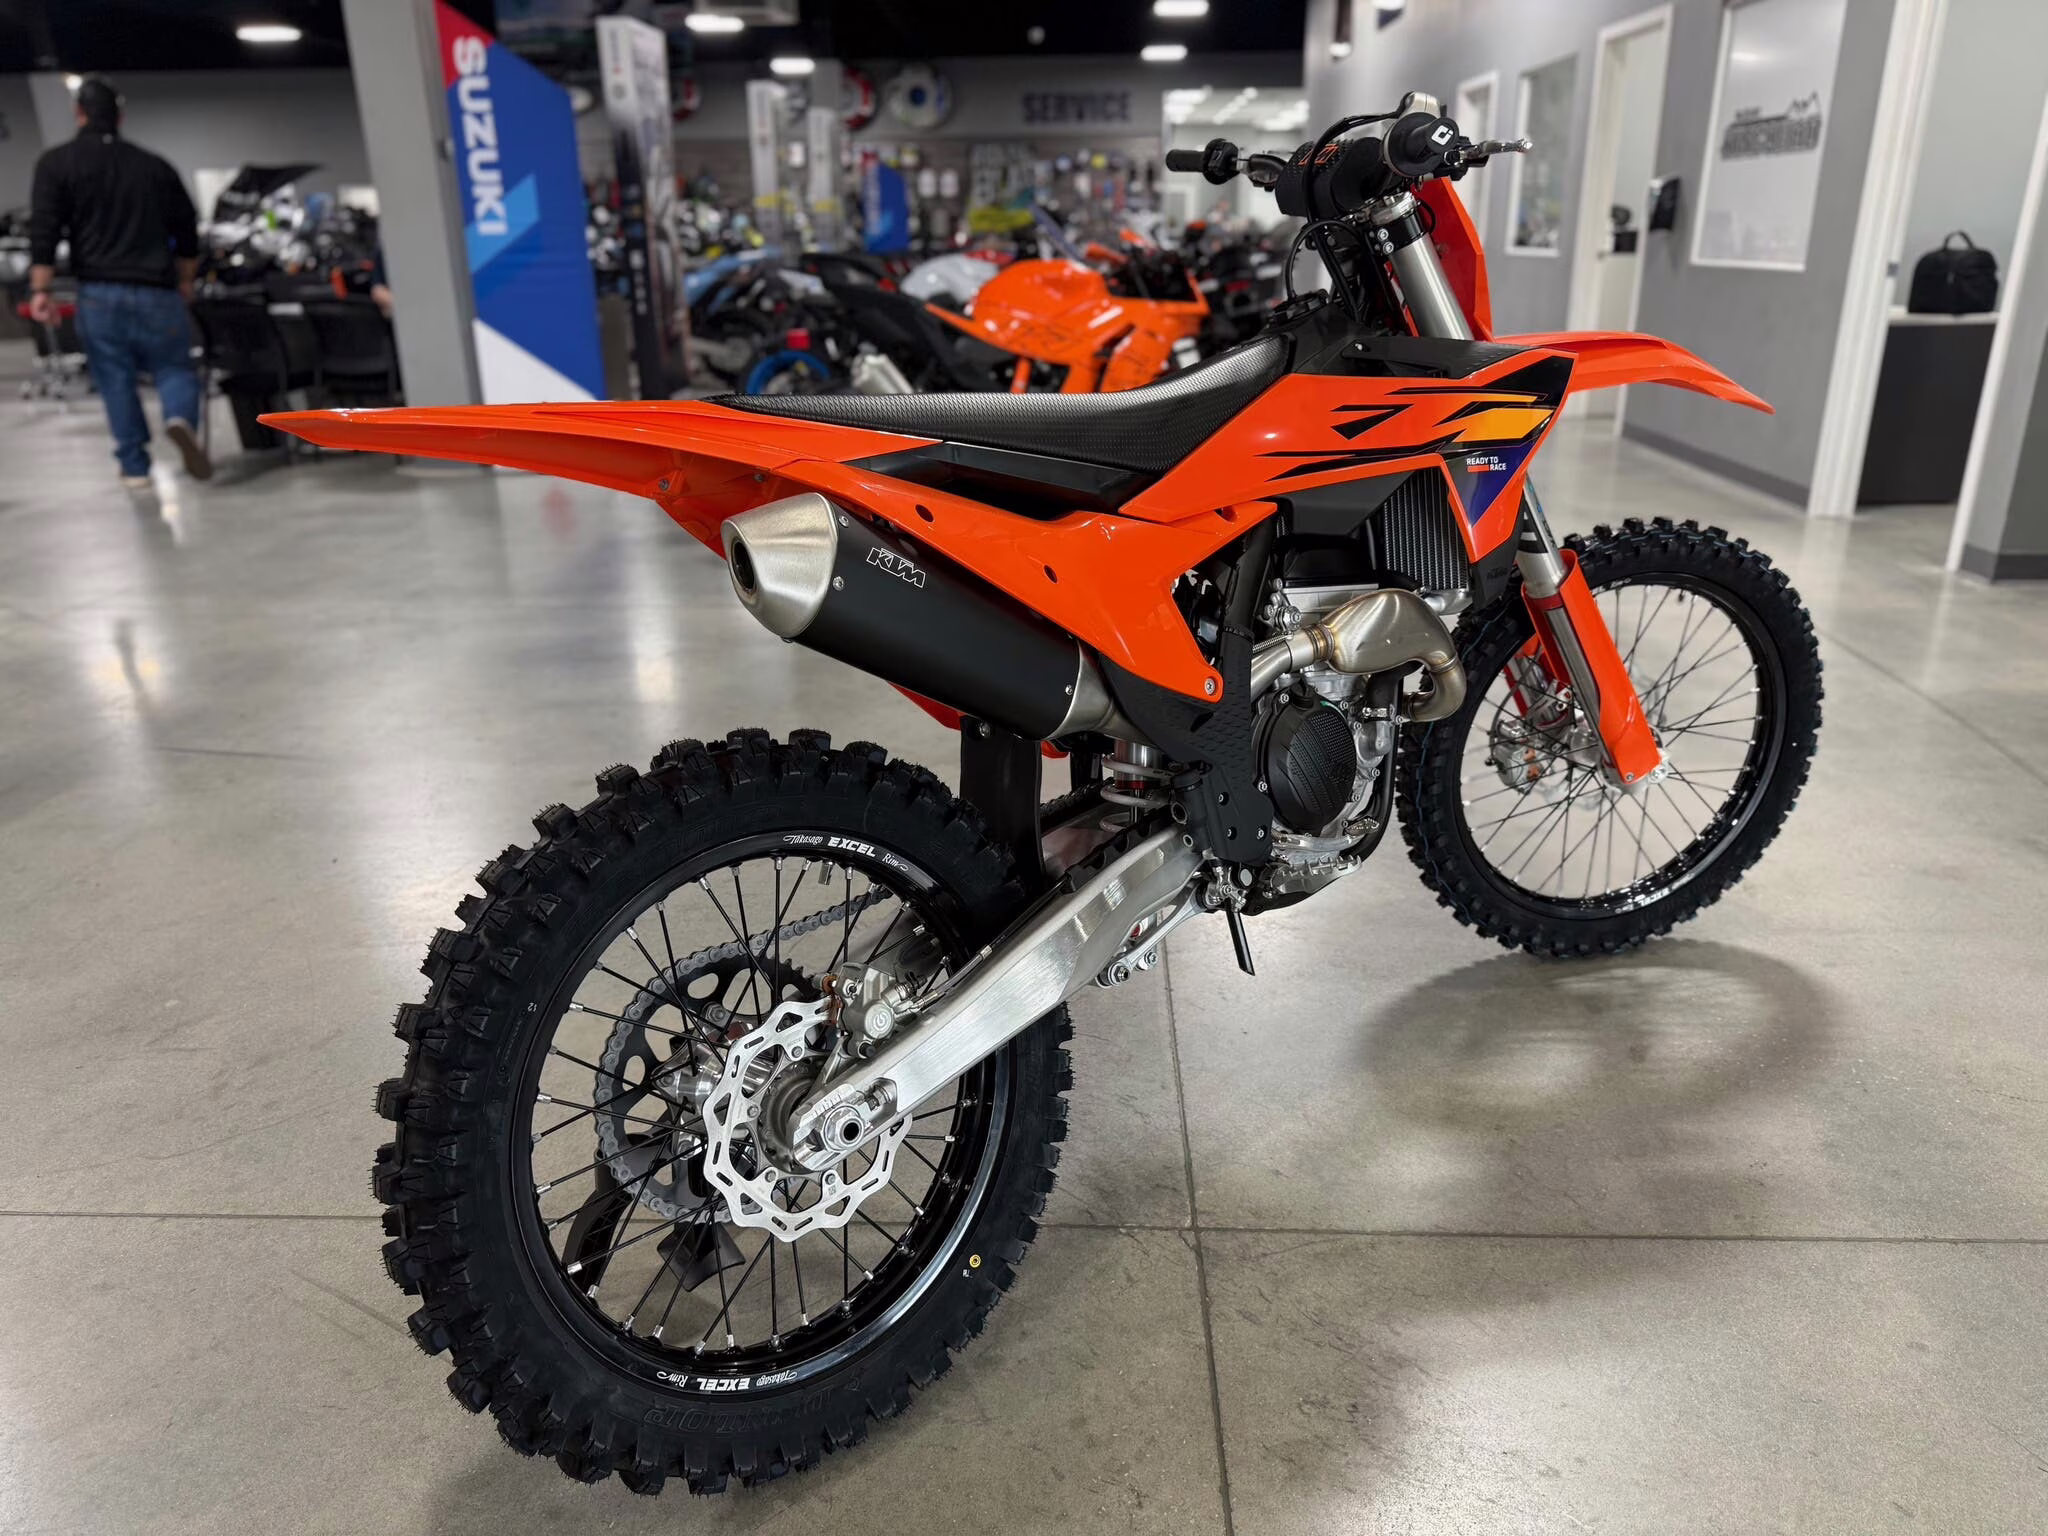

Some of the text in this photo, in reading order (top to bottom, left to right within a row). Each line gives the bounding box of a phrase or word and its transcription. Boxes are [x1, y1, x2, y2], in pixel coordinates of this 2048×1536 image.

[1022, 93, 1131, 123] SERVICE
[453, 36, 509, 236] SUZUKI
[1466, 456, 1498, 466] READY TO
[1489, 463, 1506, 471] RACE
[866, 547, 926, 588] KTM
[827, 836, 876, 857] EXCEL
[881, 853, 908, 871] Rim
[656, 1371, 689, 1388] Rim
[695, 1377, 750, 1391] EXCEL
